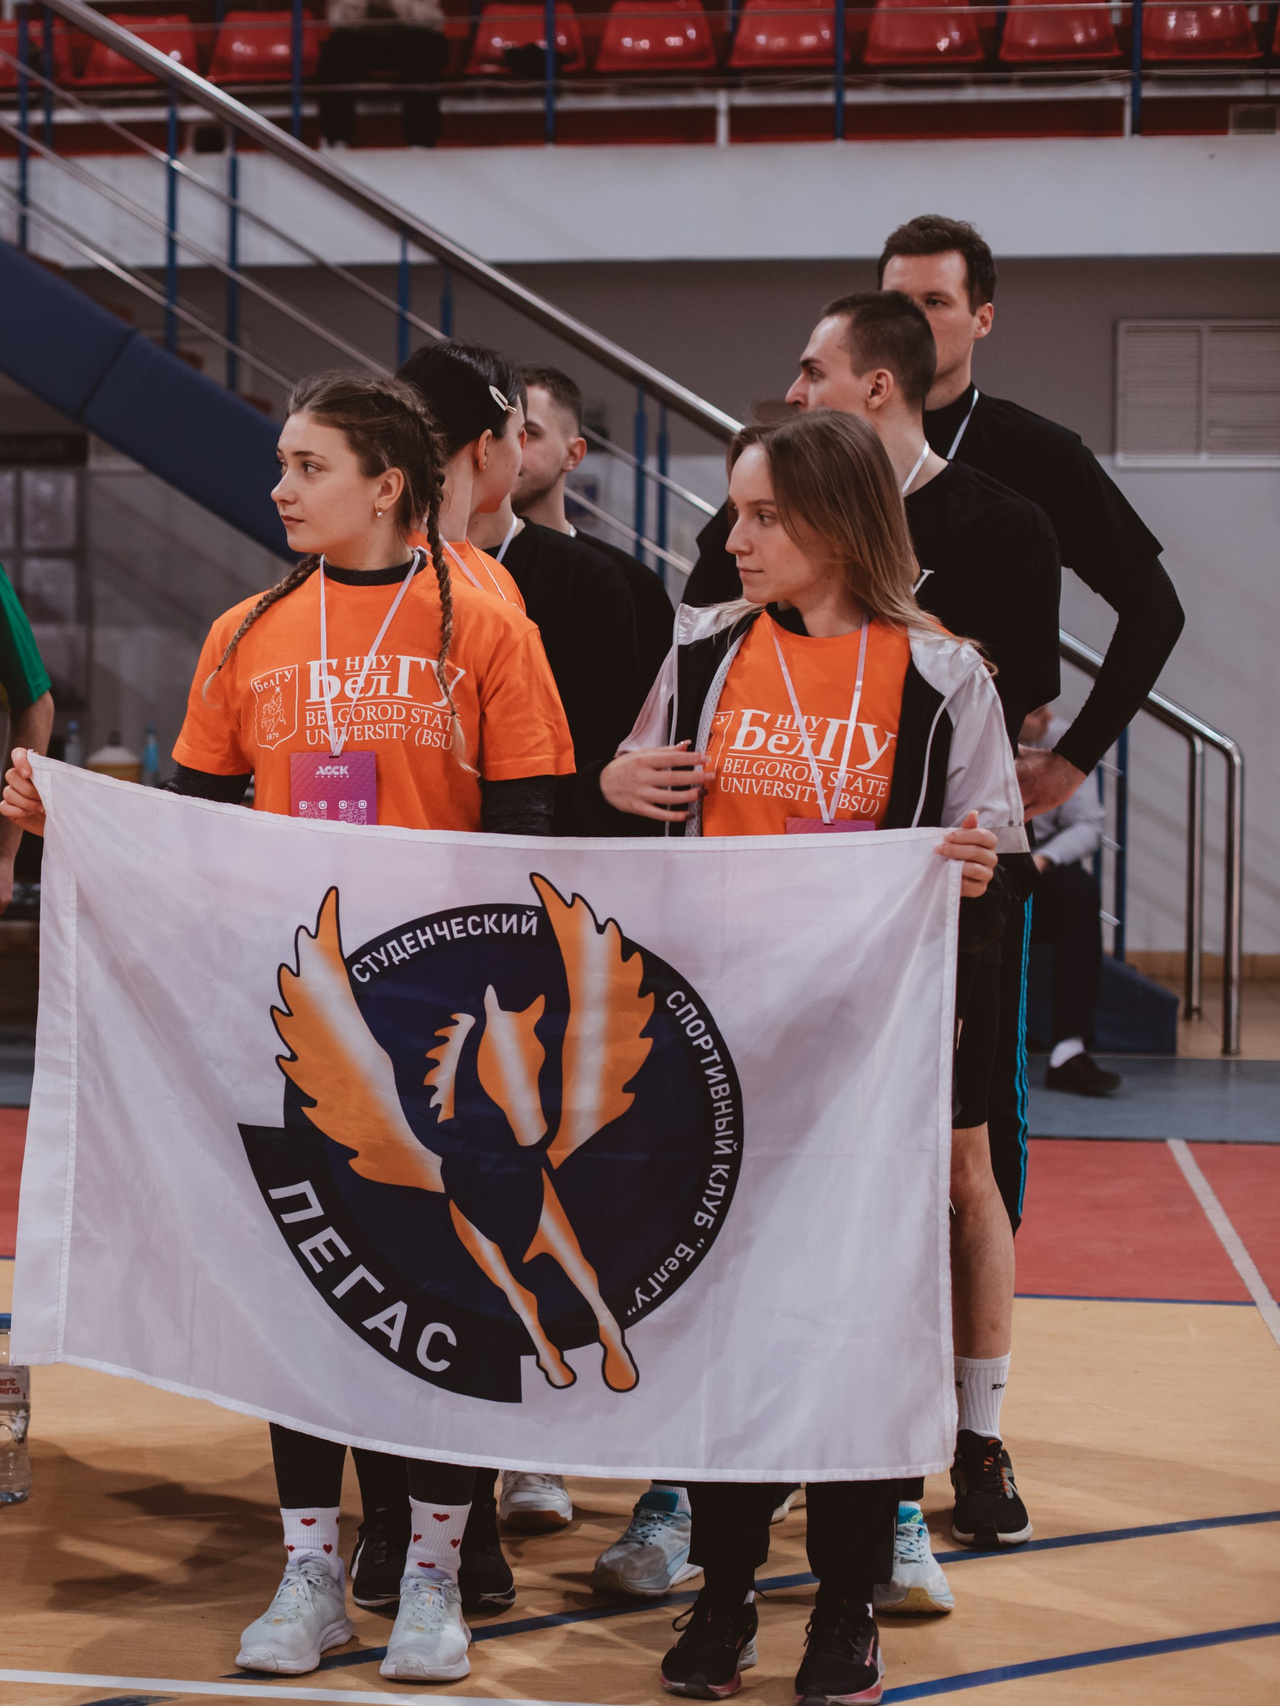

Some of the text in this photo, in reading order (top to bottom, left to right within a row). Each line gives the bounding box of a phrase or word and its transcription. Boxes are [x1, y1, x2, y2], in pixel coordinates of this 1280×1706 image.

[254, 669, 293, 693] БелГУ
[305, 655, 466, 707] БелГУ
[266, 732, 280, 741] 1876
[410, 707, 461, 731] STAT
[414, 727, 454, 752] (BSU
[729, 709, 897, 771] БелГУ
[722, 758, 888, 797] BELGOROD STATE
[837, 793, 880, 817] BSU)
[351, 911, 538, 983] СТУДЕНЧЕСКИЙ
[666, 990, 738, 1155] СПОРТИВНЫЙ
[693, 1163, 730, 1229] КЛУБ
[268, 1179, 459, 1373] ПЕГАС
